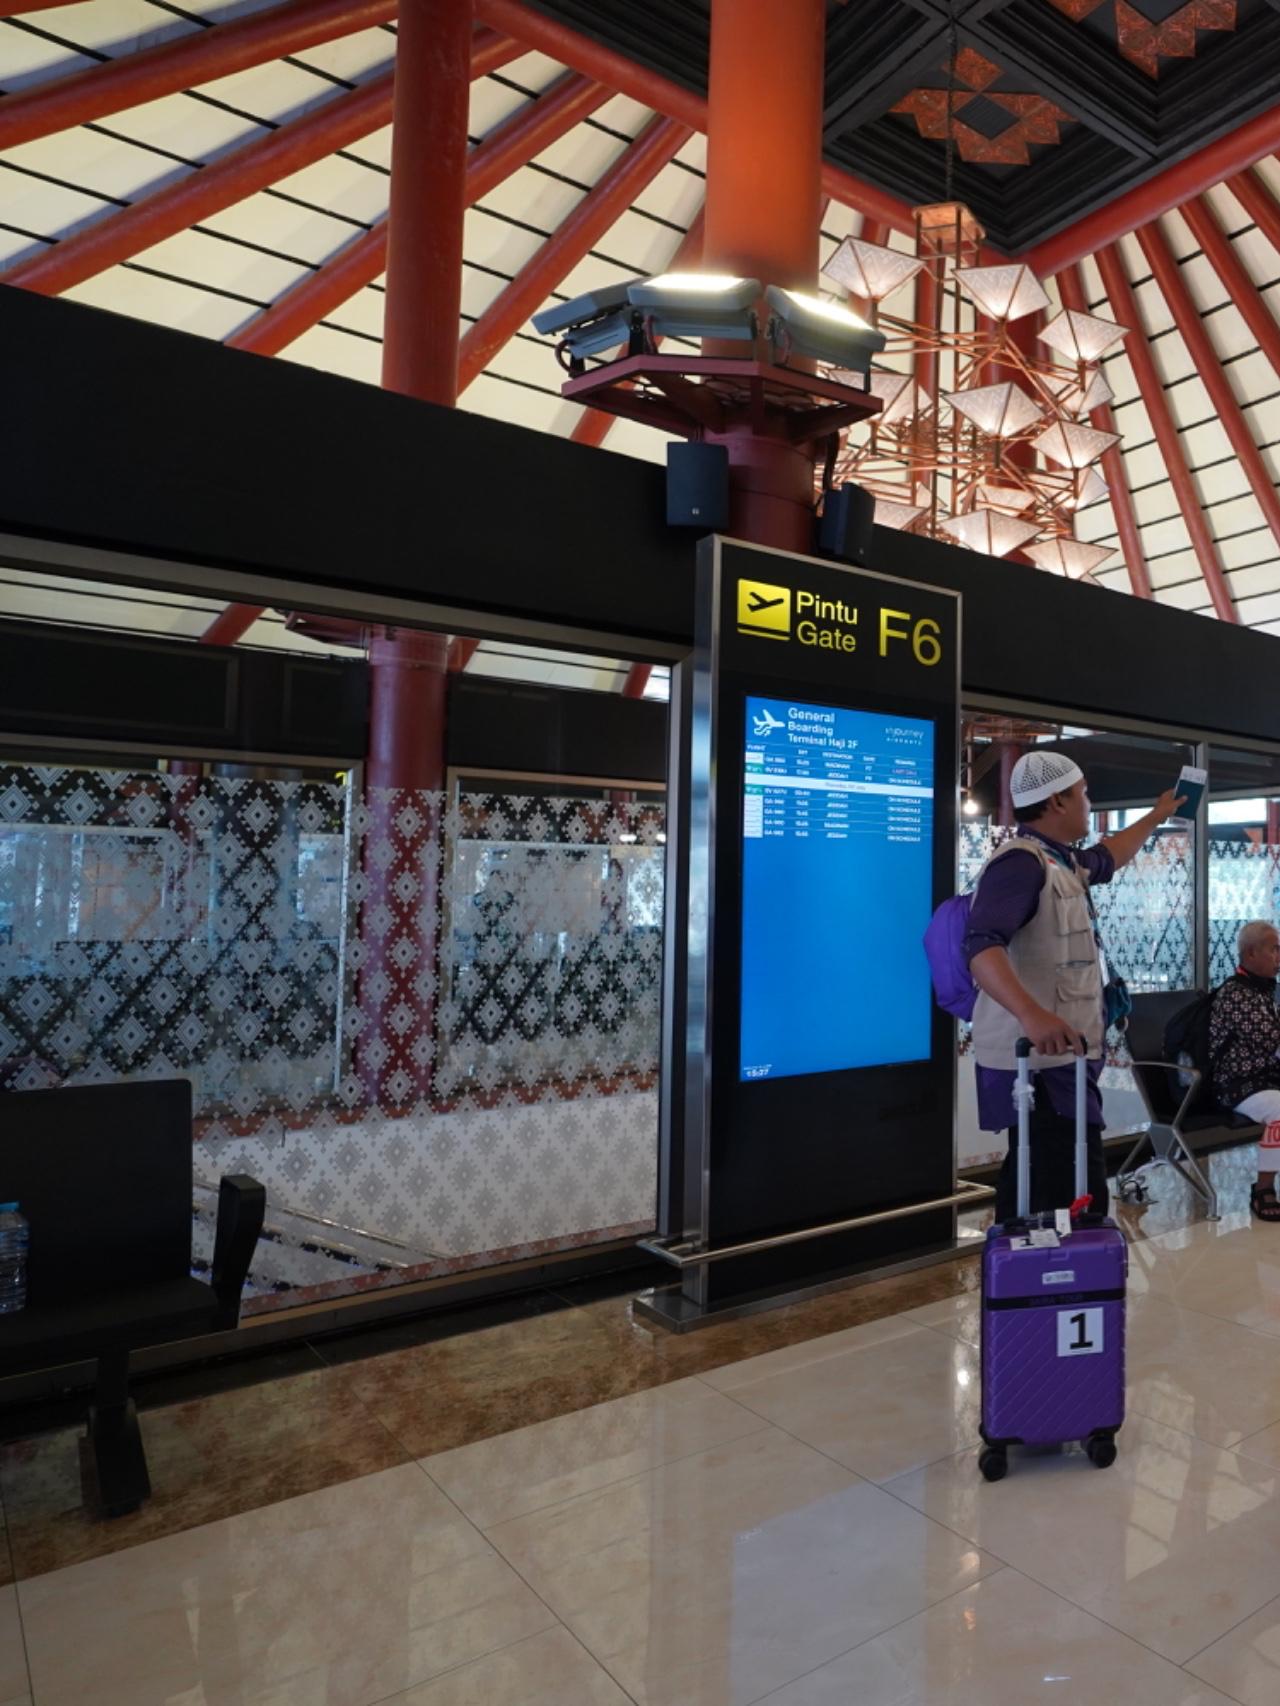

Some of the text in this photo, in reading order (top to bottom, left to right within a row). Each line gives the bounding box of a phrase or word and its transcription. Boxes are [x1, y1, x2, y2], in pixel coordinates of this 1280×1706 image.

[796, 590, 858, 625] Pintu
[796, 621, 857, 652] Gate
[879, 608, 942, 666] F6
[788, 707, 835, 723] General
[788, 721, 834, 737] Boarding
[788, 733, 859, 749] Terminal Haji 2F
[1069, 1312, 1093, 1350] 1
